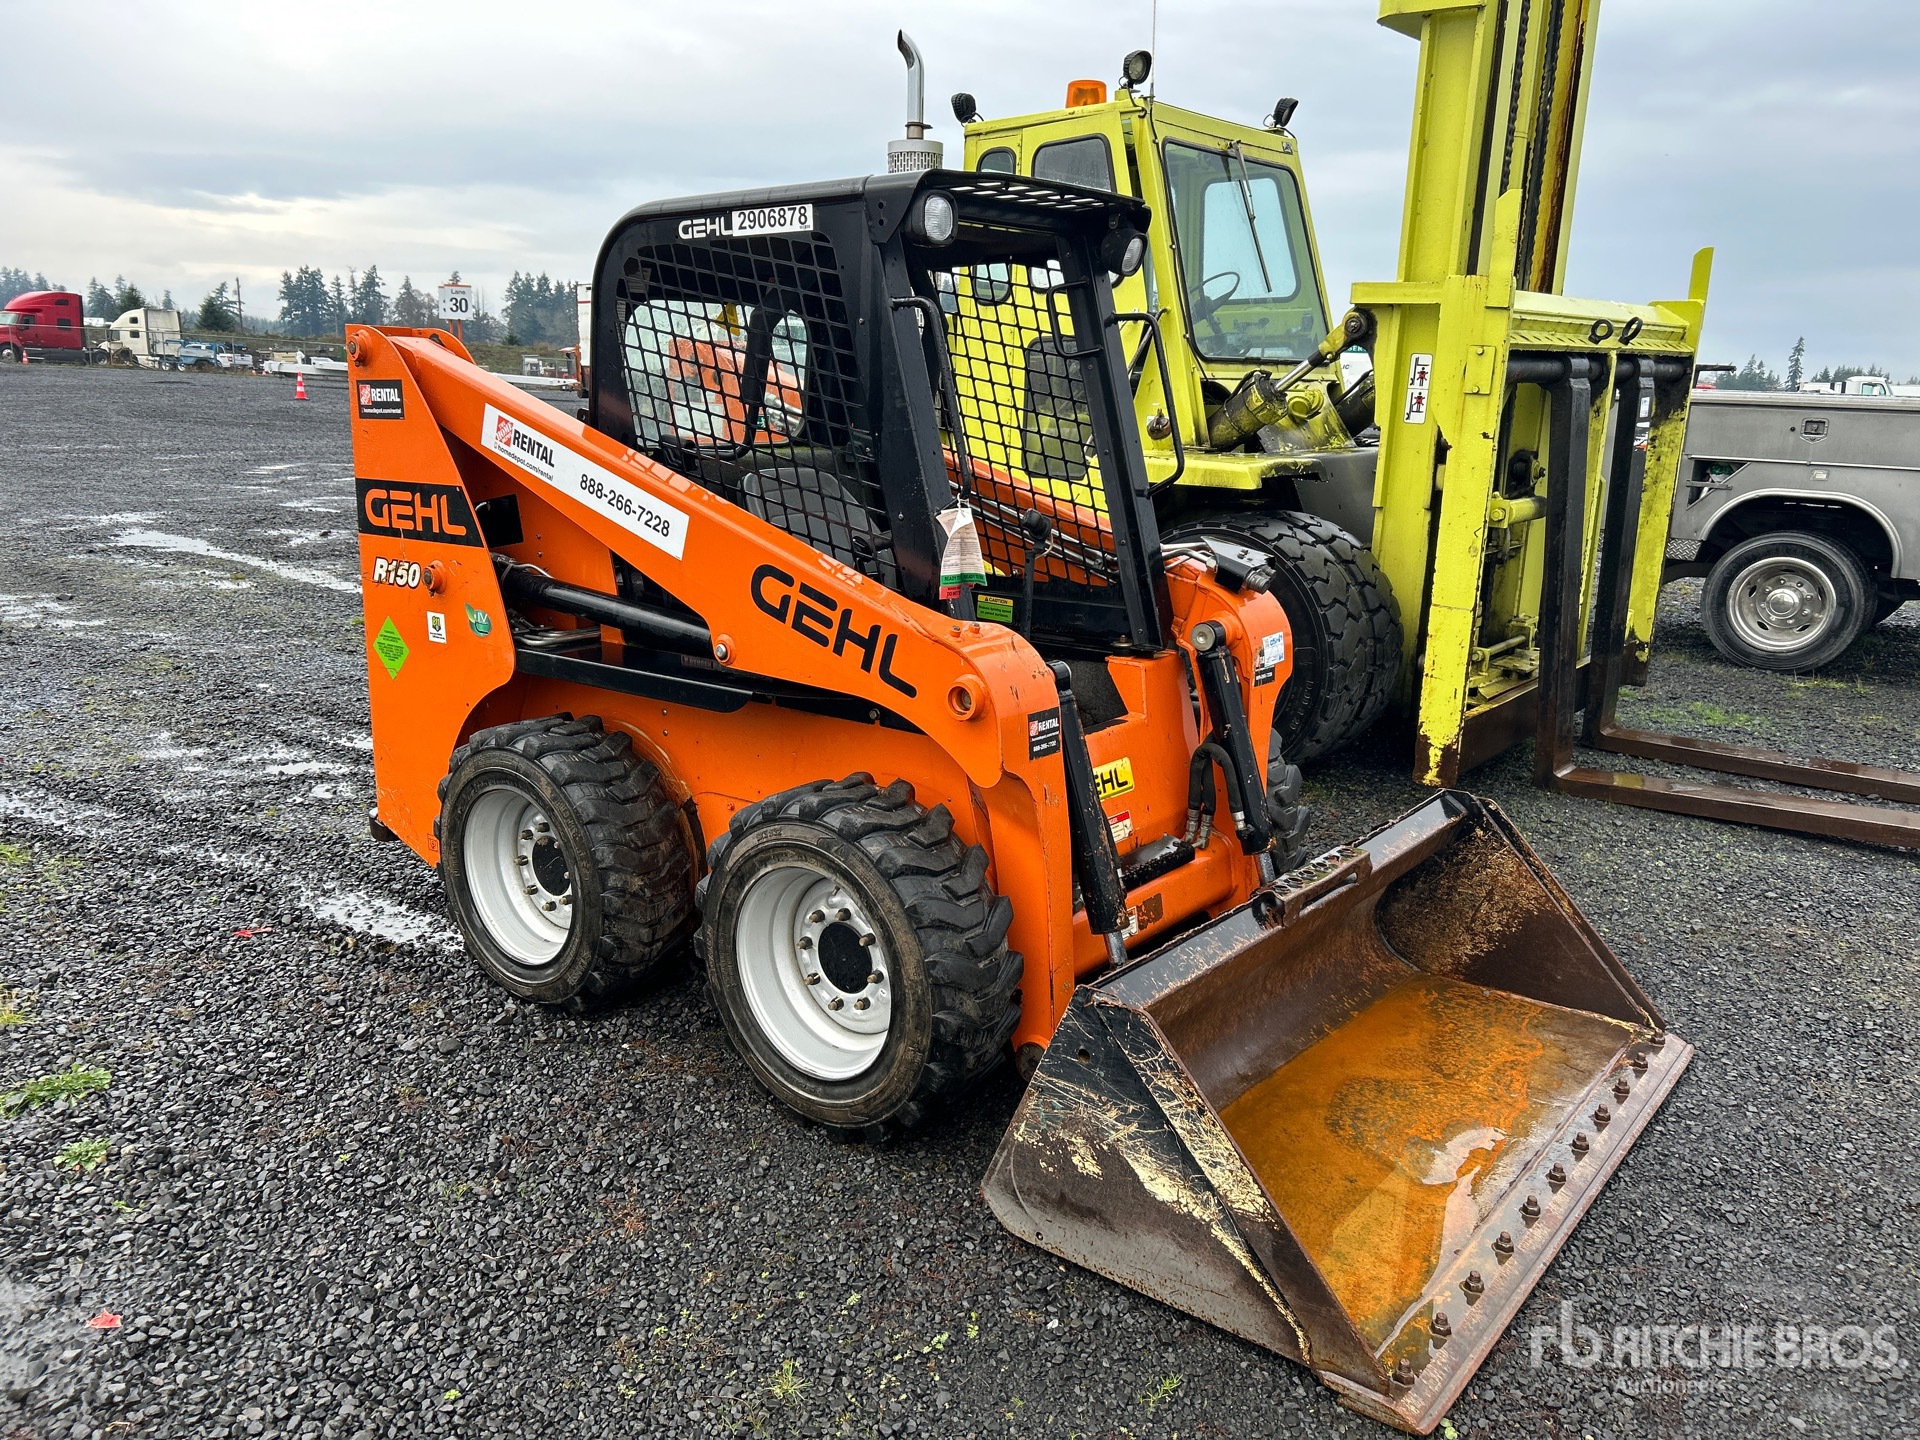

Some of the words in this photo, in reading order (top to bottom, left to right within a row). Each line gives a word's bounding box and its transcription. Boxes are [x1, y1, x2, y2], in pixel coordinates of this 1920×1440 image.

[678, 216, 733, 240] GEHL
[737, 205, 808, 231] 2906878
[449, 297, 469, 313] 30
[371, 388, 401, 402] RENTAL
[497, 445, 553, 482] homedepot.com/rental
[512, 428, 555, 468] RENTAL
[364, 488, 467, 537] GEHL
[579, 473, 671, 538] 888-266-7228
[373, 556, 422, 589] R150
[750, 563, 918, 699] GEHL
[1038, 718, 1060, 732] RENTAL
